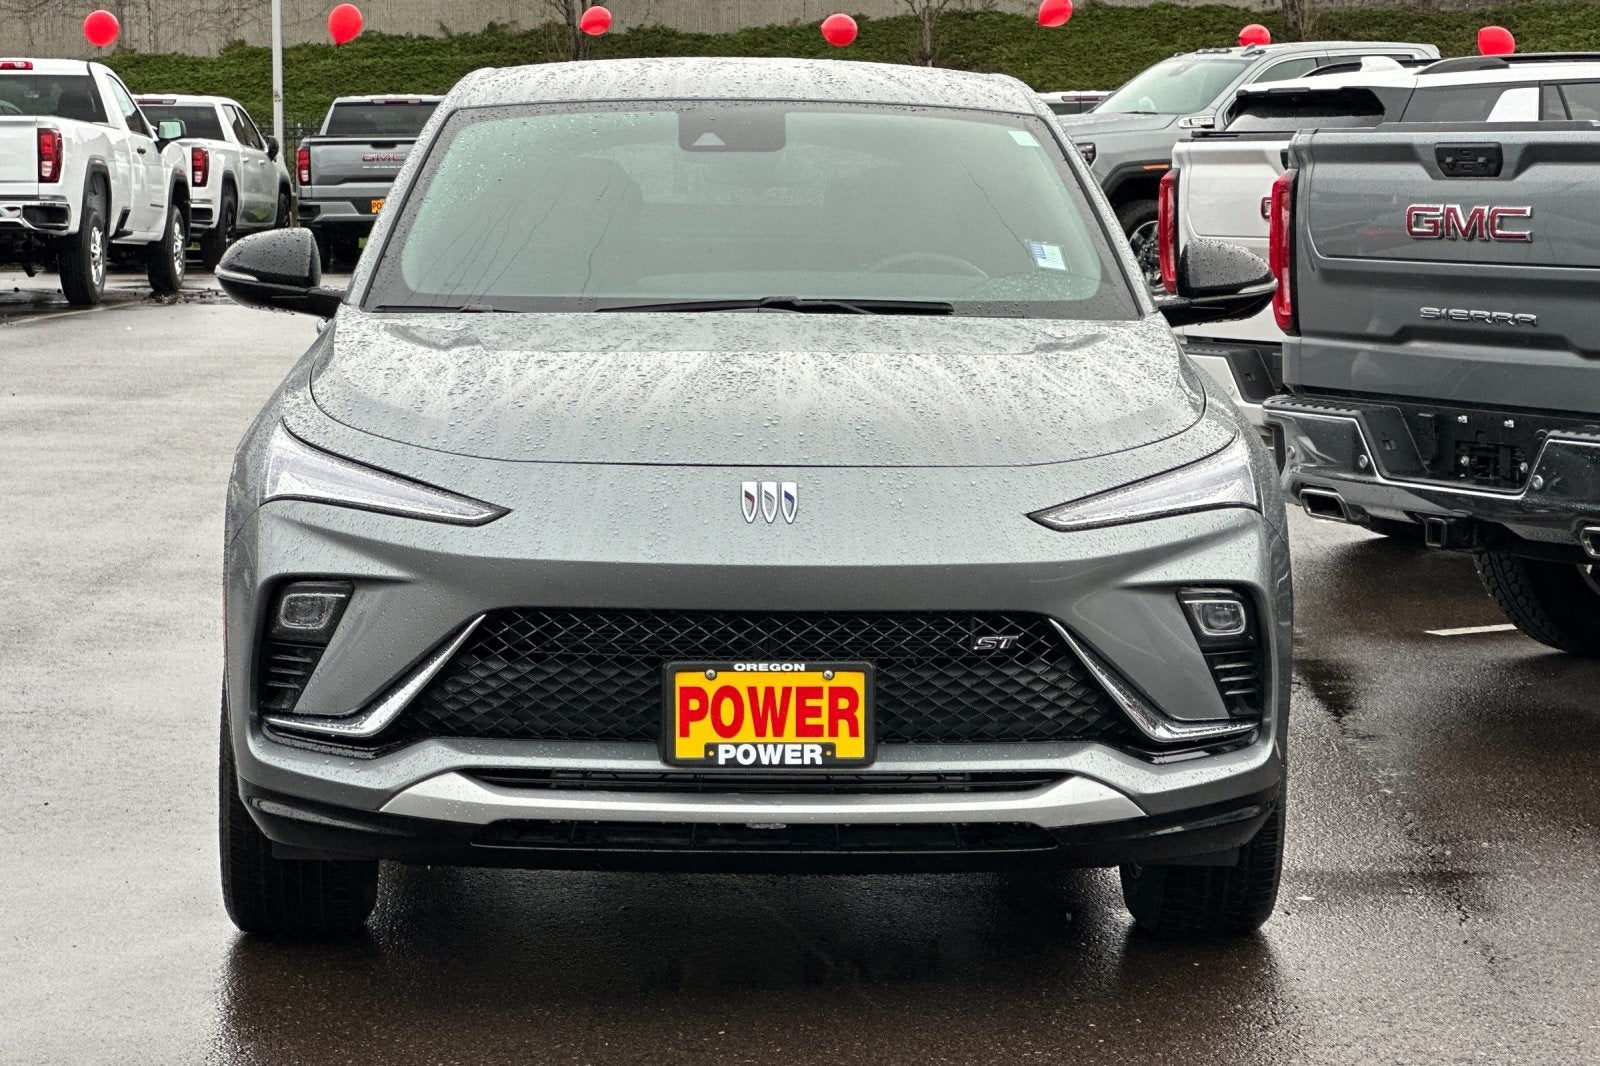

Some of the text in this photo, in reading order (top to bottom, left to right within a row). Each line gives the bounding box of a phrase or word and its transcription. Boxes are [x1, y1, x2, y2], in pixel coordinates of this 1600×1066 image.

[1406, 203, 1532, 242] GMC
[1420, 306, 1538, 326] SIERRA
[973, 635, 1019, 650] ST
[733, 663, 805, 671] OREGON
[679, 685, 860, 739] POWER
[717, 744, 823, 765] POWER
